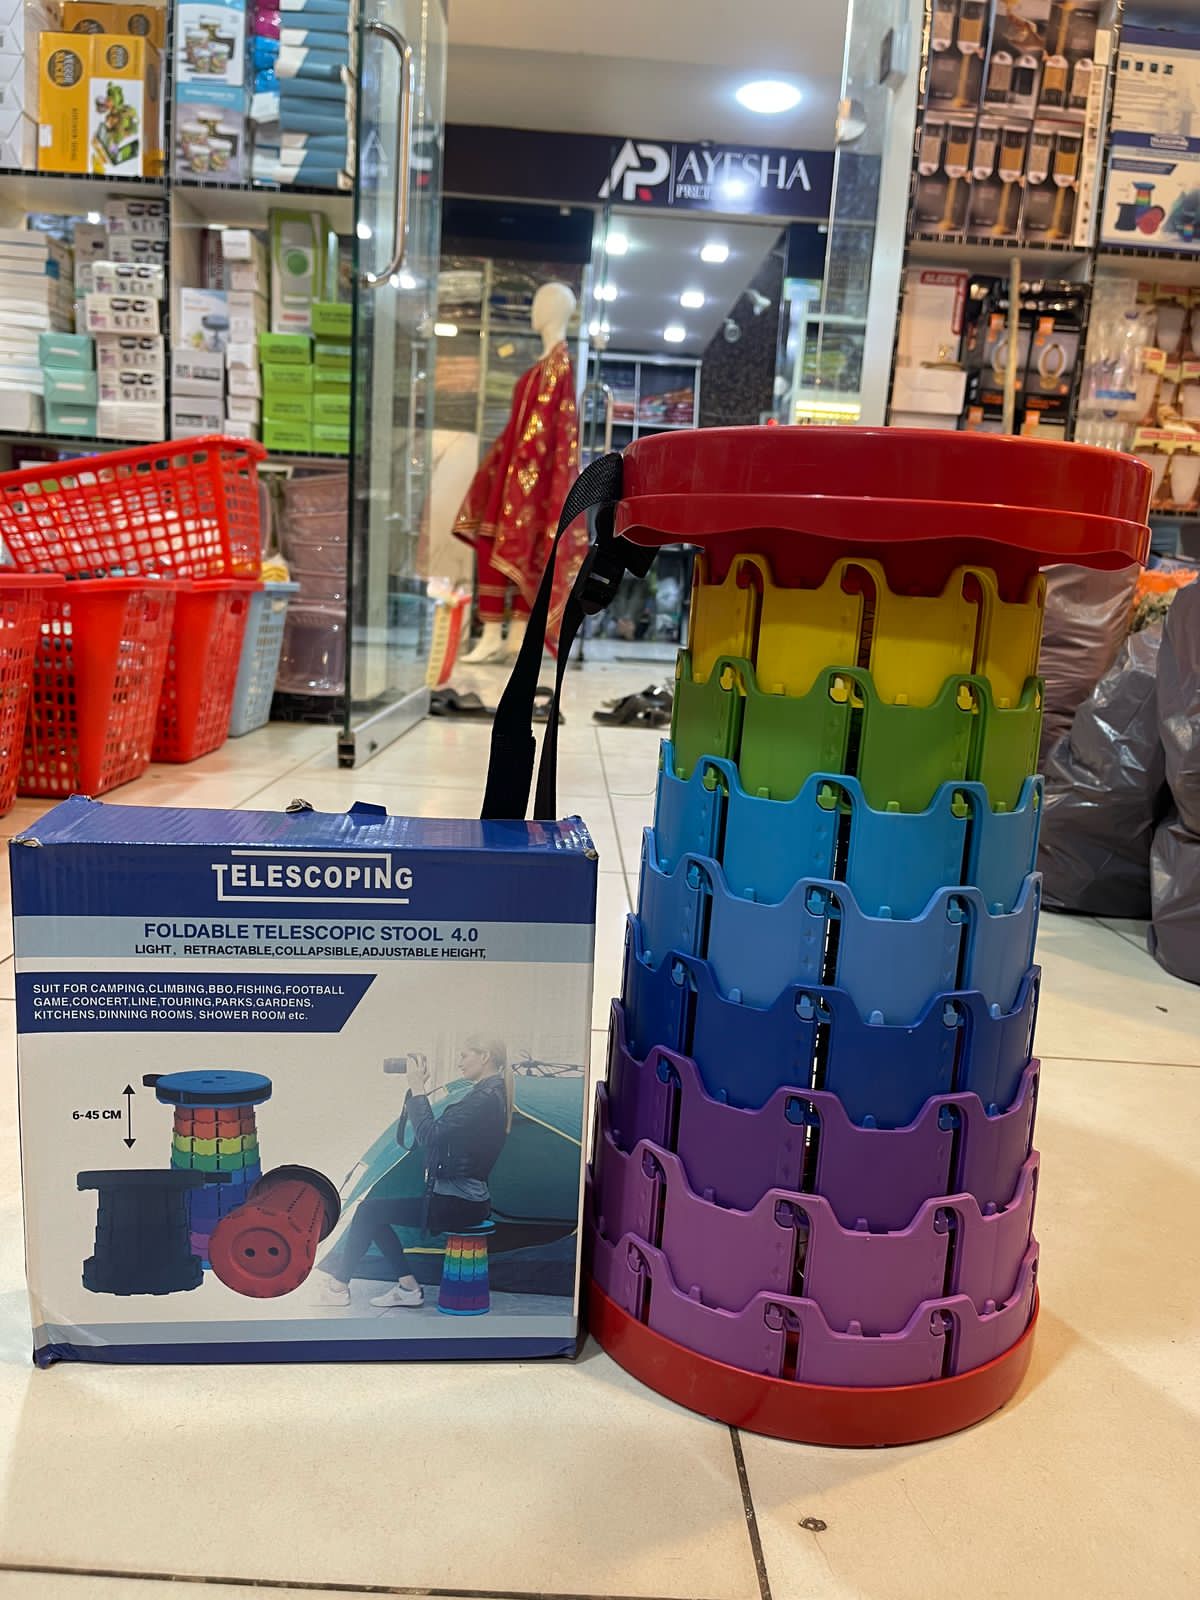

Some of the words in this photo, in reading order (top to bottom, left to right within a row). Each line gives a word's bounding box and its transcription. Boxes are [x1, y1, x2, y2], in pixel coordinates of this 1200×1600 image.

[211, 856, 413, 900] TELESCOPING
[144, 923, 249, 939] FOLDABLE
[253, 924, 376, 941] TELESCOPIC
[380, 926, 443, 941] STOOL
[450, 927, 479, 942] 4.0
[441, 948, 487, 959] HEIGHT,
[32, 984, 60, 994] SUIT
[63, 984, 88, 994] FOR
[199, 1010, 249, 1020] SHOWER
[251, 1011, 286, 1021] ROOM
[72, 1110, 100, 1120] 6-45
[102, 1110, 122, 1120] CM
